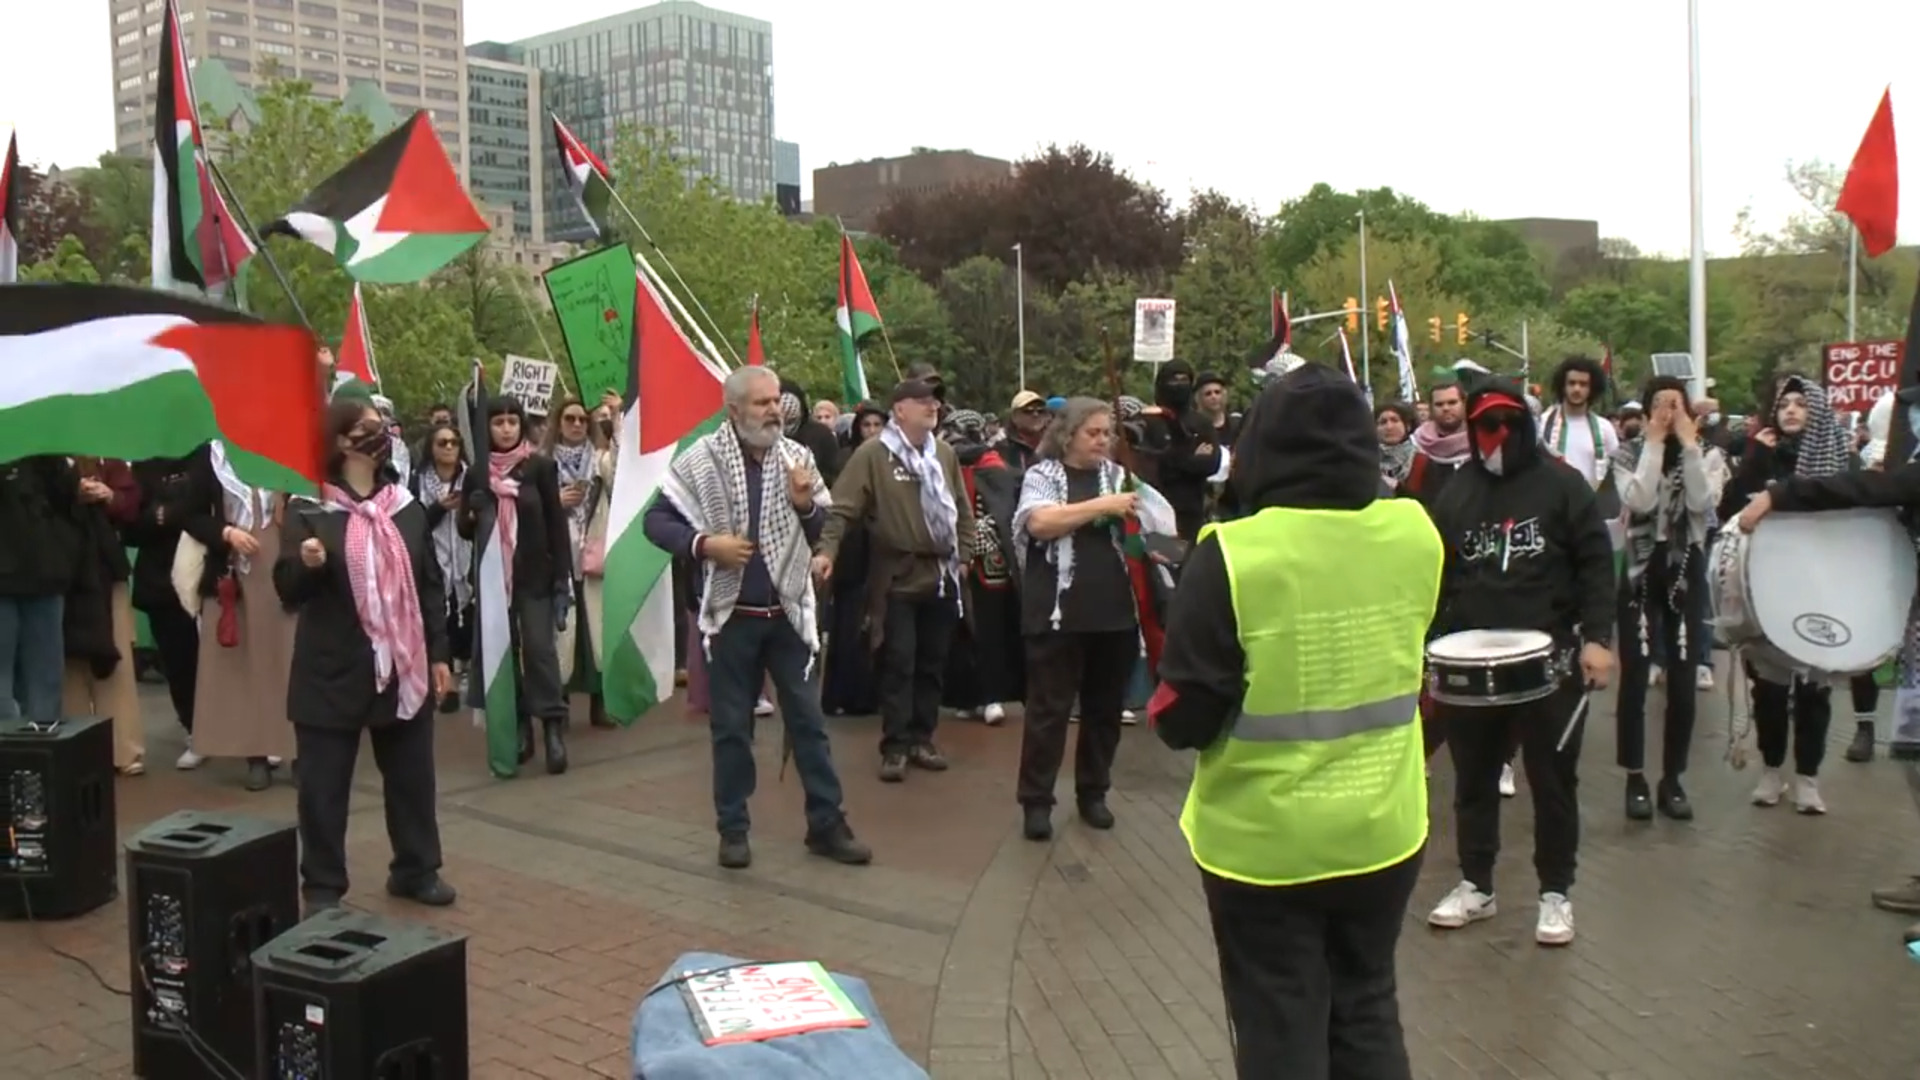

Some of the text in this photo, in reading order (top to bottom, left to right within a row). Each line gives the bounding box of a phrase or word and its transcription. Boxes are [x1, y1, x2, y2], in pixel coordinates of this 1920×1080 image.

[1829, 343, 1898, 361] END THE
[512, 361, 550, 381] RIGHT
[514, 381, 534, 391] OF
[774, 976, 839, 1014] LAND
